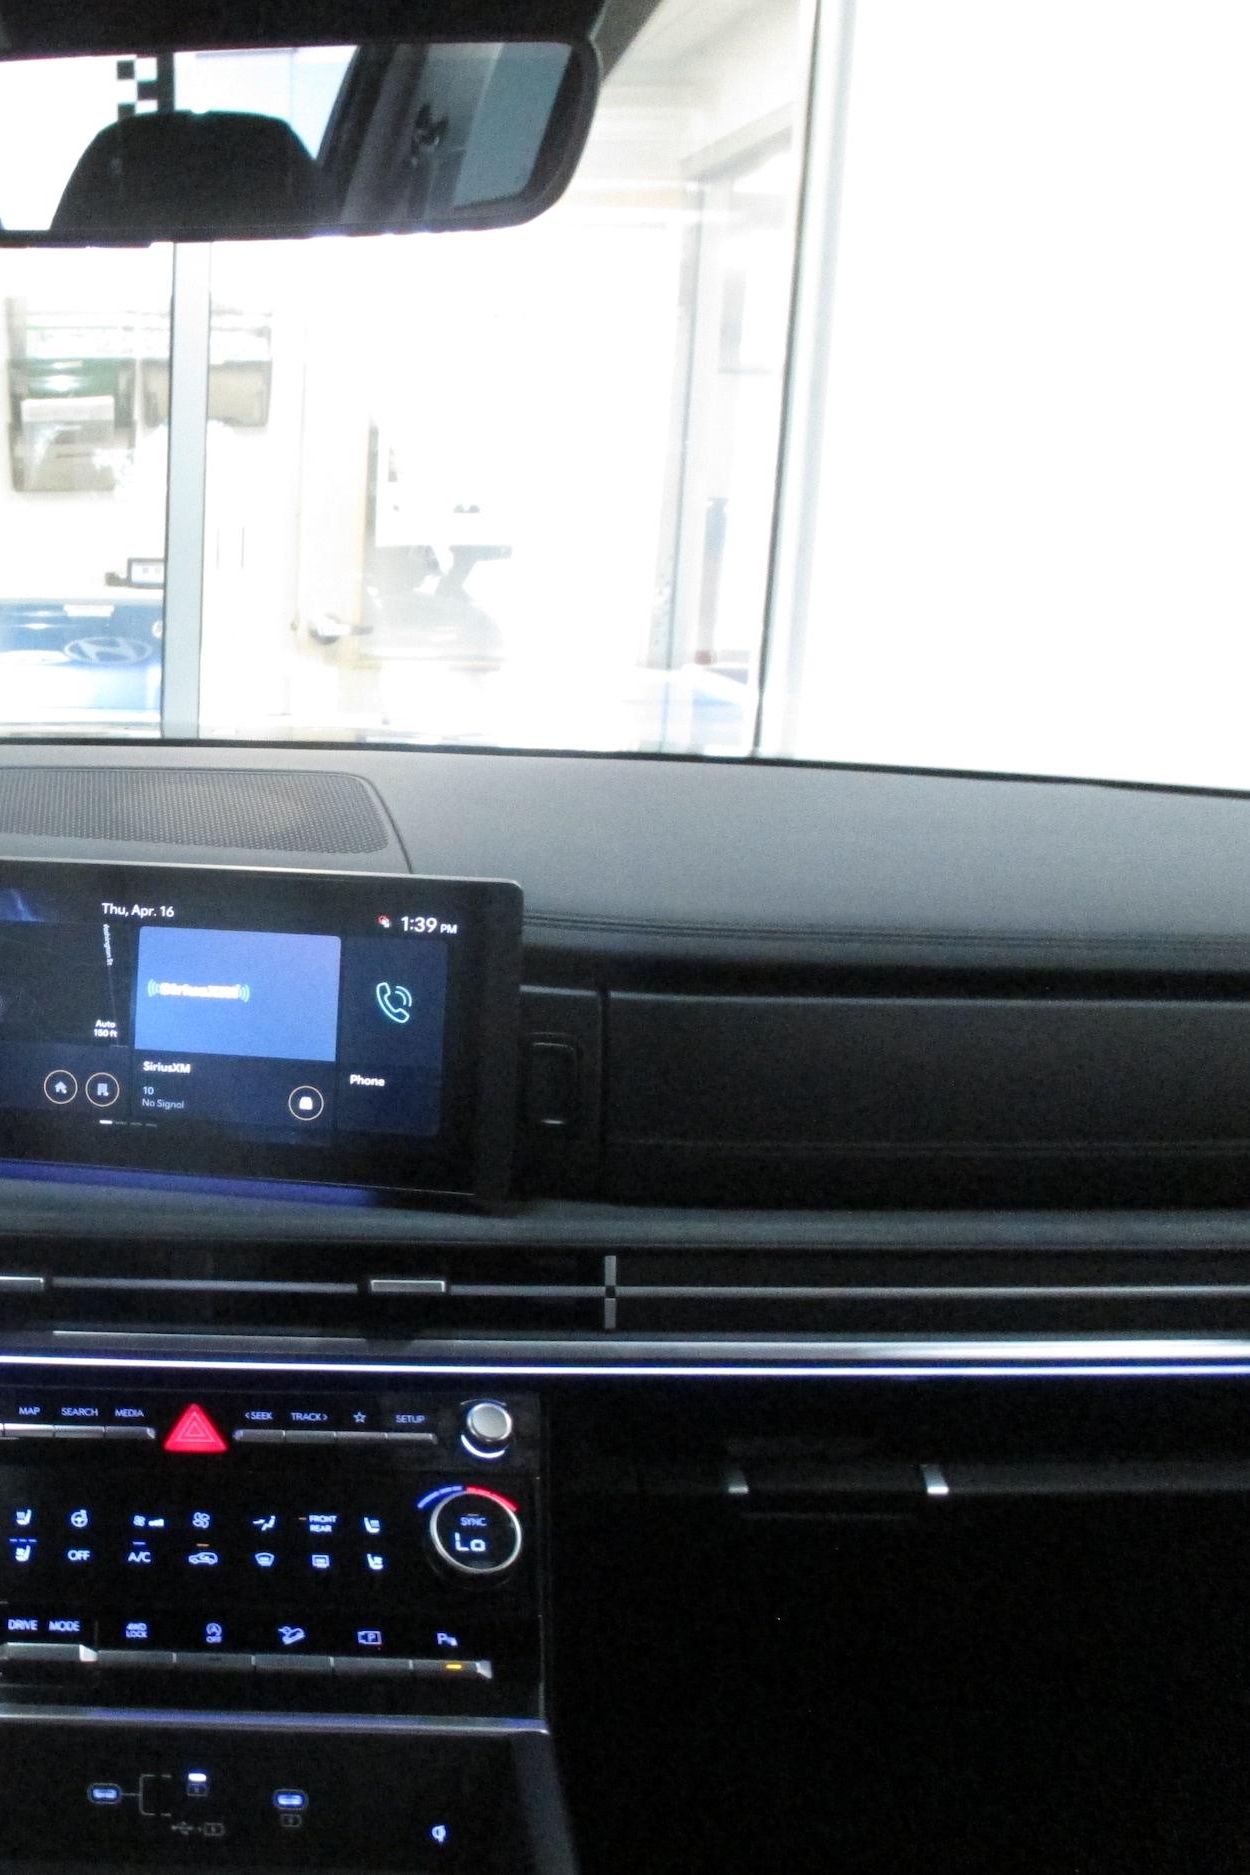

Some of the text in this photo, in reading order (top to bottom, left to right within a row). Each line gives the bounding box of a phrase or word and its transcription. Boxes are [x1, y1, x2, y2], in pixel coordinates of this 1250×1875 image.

[101, 902, 175, 918] Thu, Apr. 16
[400, 916, 458, 935] 1:39 PM
[143, 1061, 191, 1074] SiriusXM
[350, 1075, 385, 1087] Phone
[143, 1086, 155, 1096] 10
[142, 1099, 185, 1111] No Signal
[18, 1406, 41, 1416] MAP
[61, 1407, 99, 1417] SEARCH
[114, 1408, 145, 1418] MEDIA
[395, 1414, 425, 1424] SETUP
[308, 1514, 338, 1524] FRONT
[460, 1516, 487, 1527] SYNC
[309, 1524, 332, 1533] REAR
[67, 1550, 91, 1561] OFF
[128, 1551, 152, 1563] A/C
[8, 1619, 81, 1632] DRIVE MODE
